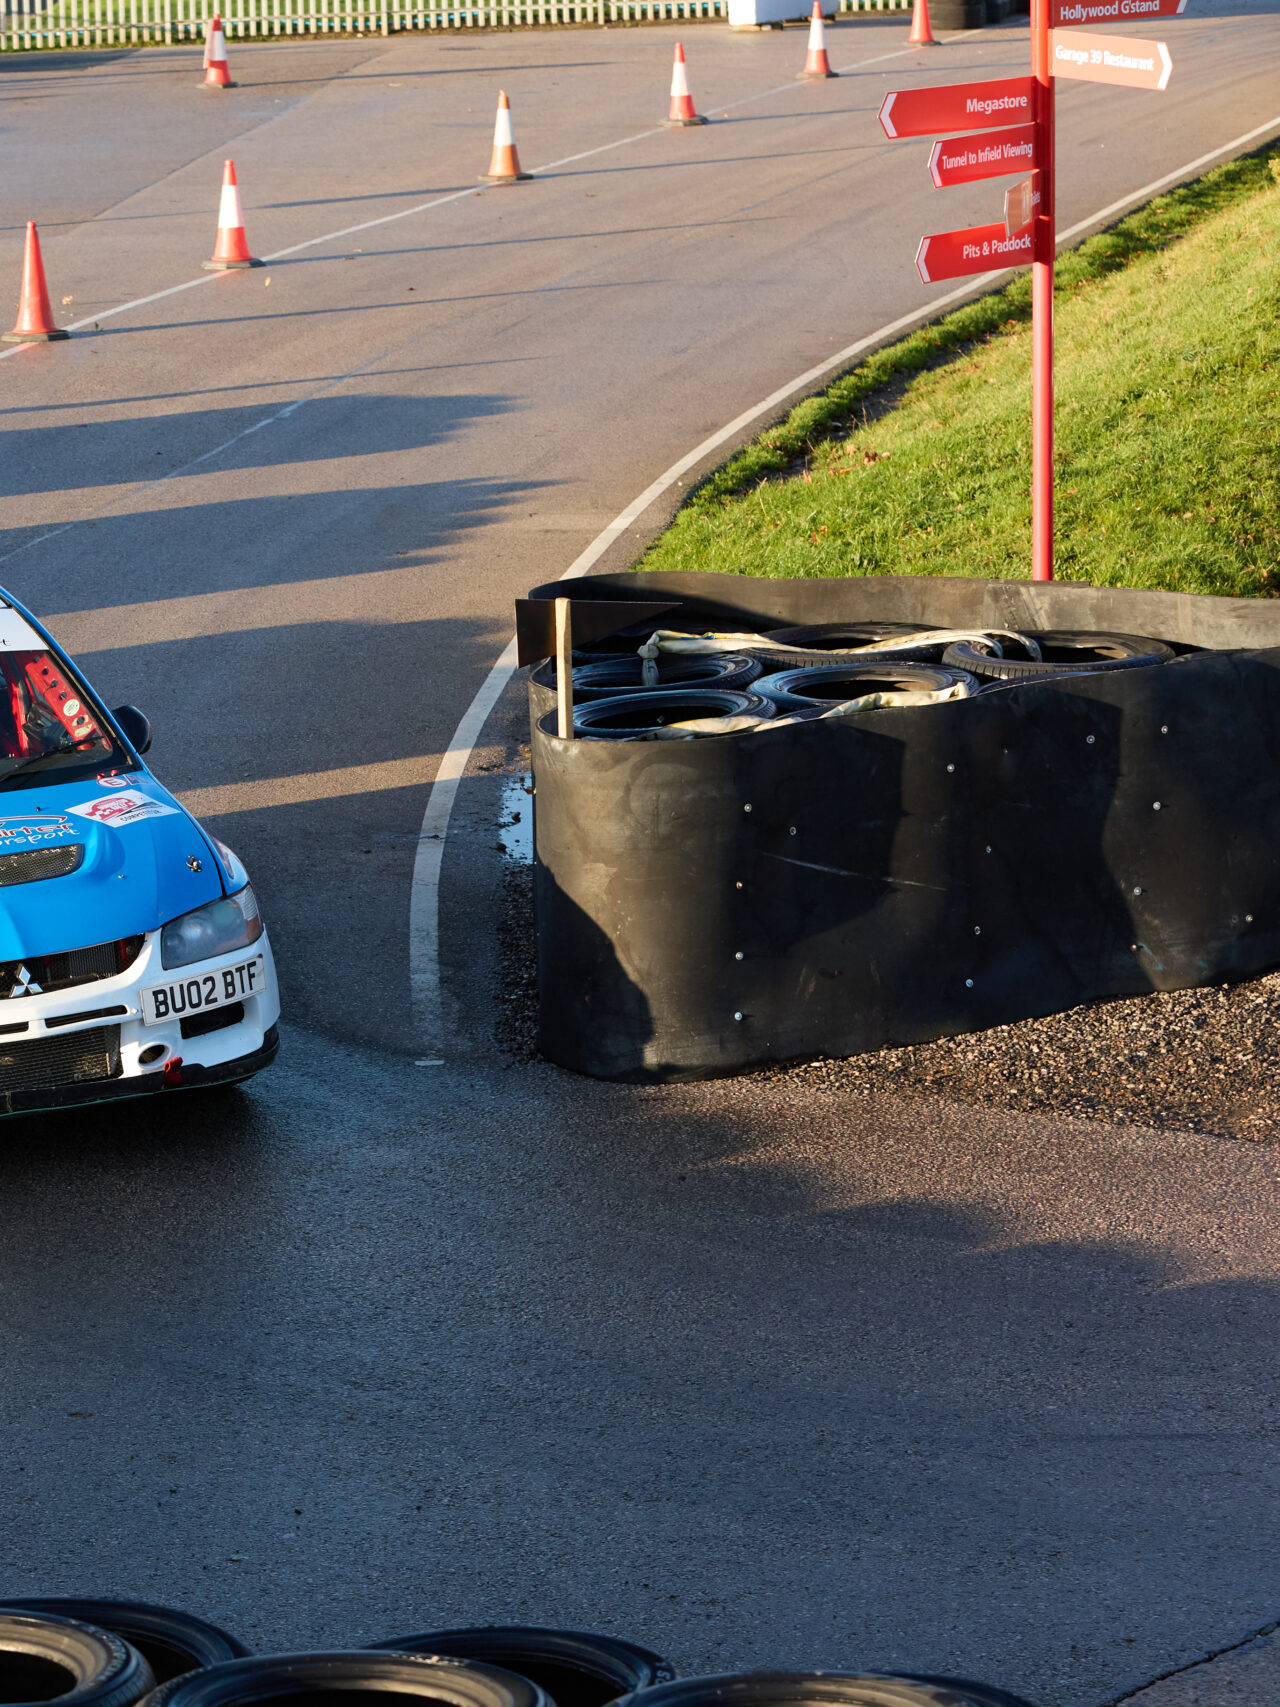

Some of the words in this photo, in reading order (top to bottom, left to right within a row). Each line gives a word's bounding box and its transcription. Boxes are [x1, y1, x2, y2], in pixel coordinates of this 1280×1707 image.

[1060, 4, 1118, 22] Hollywood
[1121, 0, 1160, 14] G'stand
[1055, 45, 1088, 66] Garage
[1090, 49, 1102, 64] 39
[1104, 51, 1154, 71] Restaurant
[966, 96, 1028, 114] Megastore
[942, 151, 967, 170] Tunnel
[968, 152, 977, 165] to
[978, 145, 1001, 163] Infield
[1003, 141, 1033, 157] Viewing
[963, 244, 980, 259] Pits
[982, 241, 990, 256] &
[991, 233, 1031, 254] Paddock
[152, 975, 218, 1019] BU02
[222, 960, 257, 999] BTF
